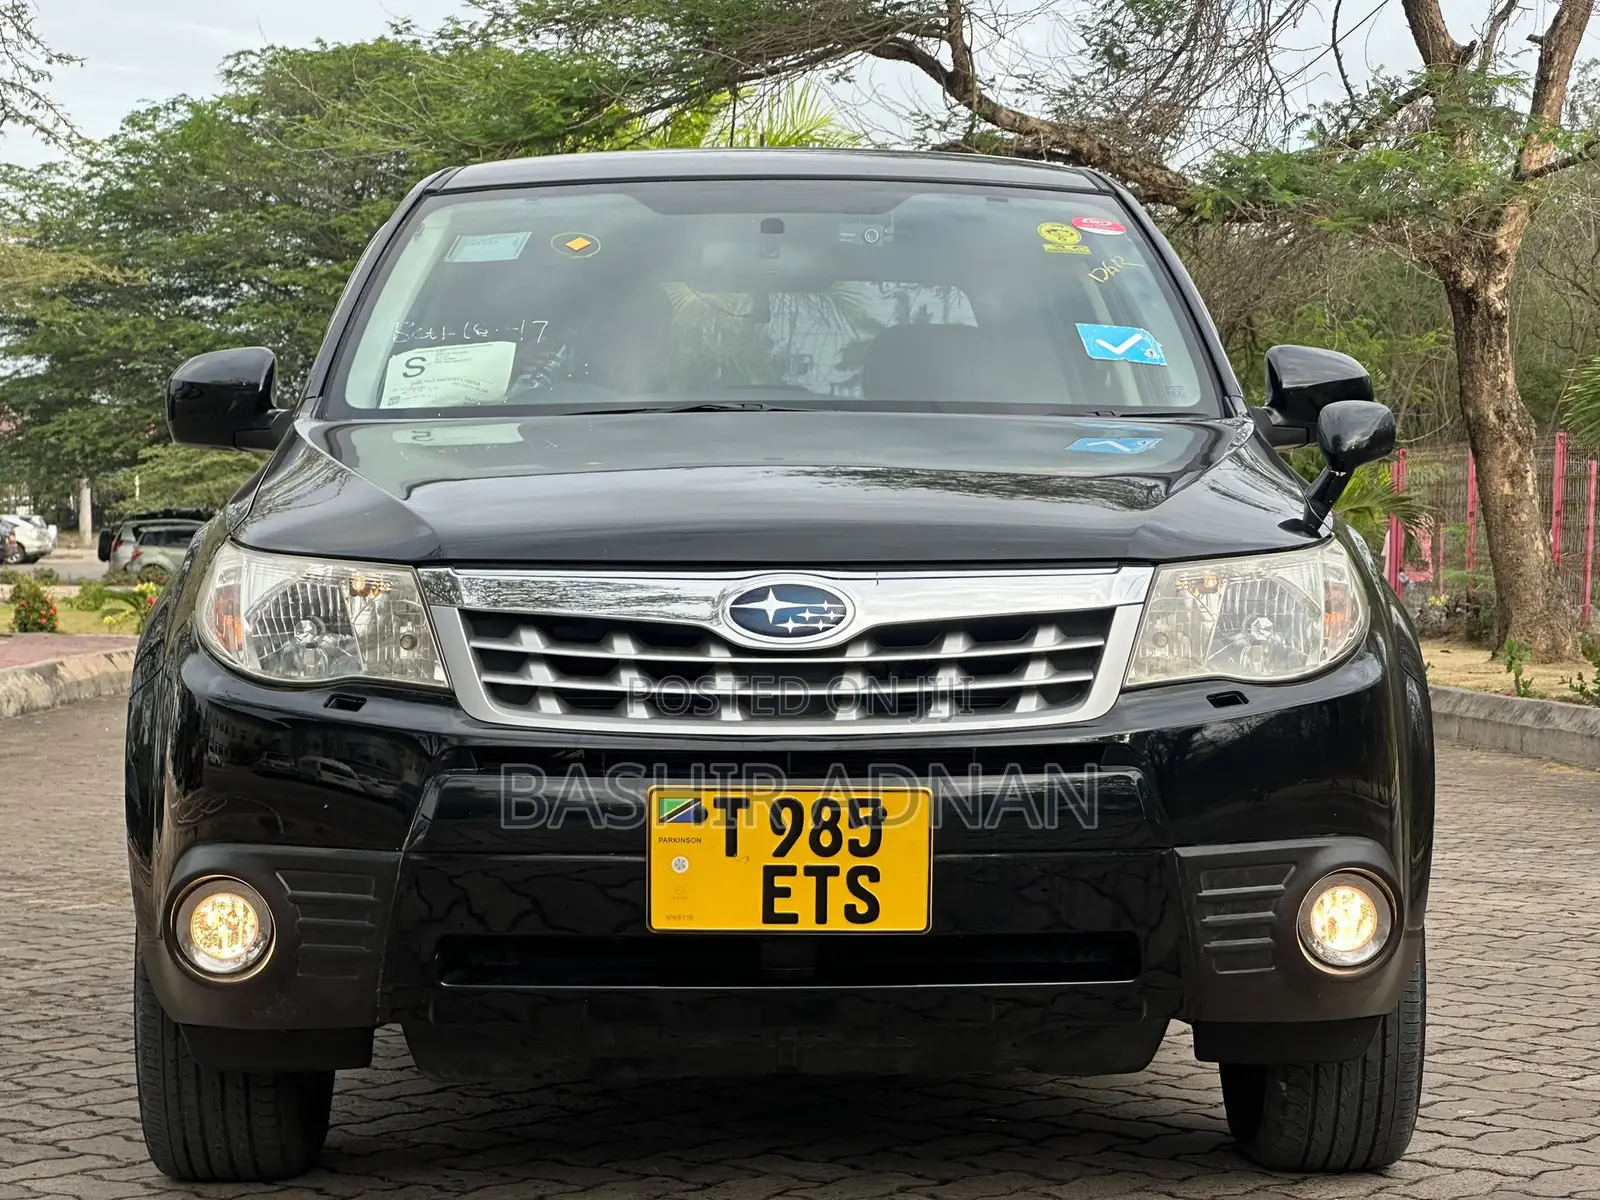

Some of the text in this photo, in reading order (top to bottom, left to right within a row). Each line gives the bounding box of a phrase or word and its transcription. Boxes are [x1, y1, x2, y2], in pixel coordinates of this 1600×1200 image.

[402, 356, 427, 378] S
[658, 836, 702, 844] PARKINSON
[713, 796, 883, 858] T 985
[761, 864, 881, 924] ETS
